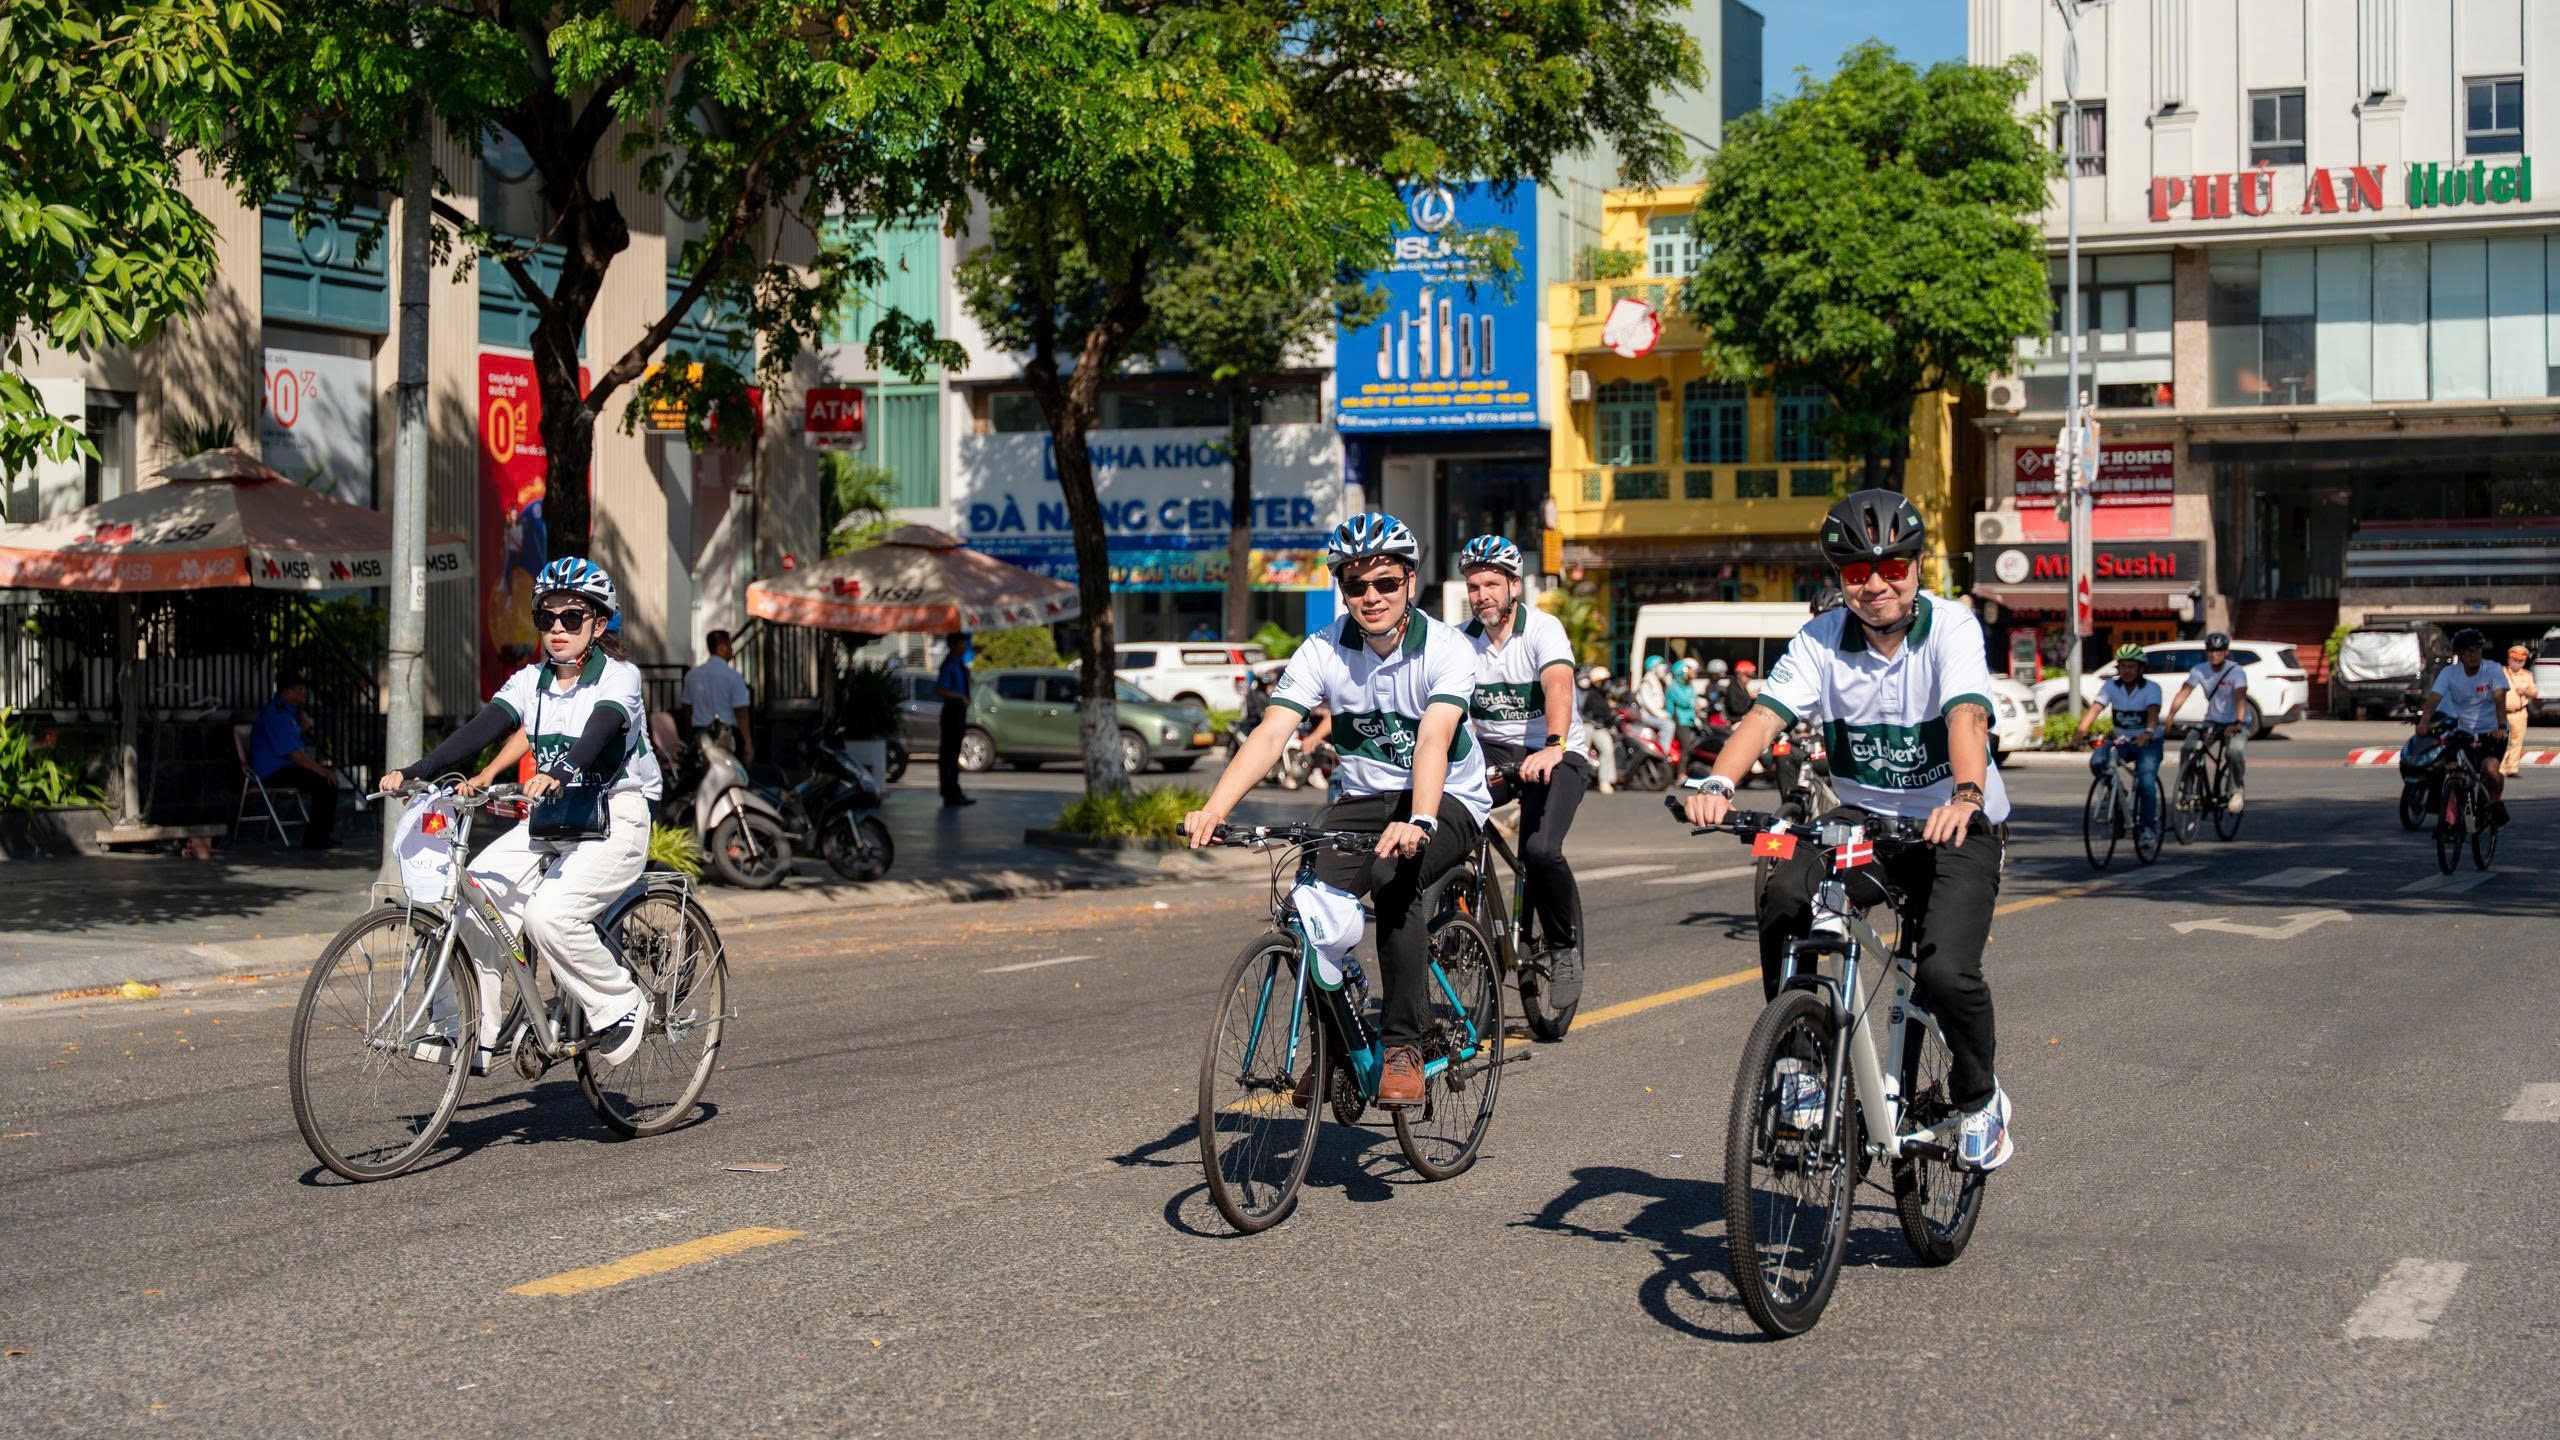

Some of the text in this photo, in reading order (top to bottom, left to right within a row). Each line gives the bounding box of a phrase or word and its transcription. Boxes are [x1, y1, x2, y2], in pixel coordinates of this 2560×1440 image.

[2150, 156, 2532, 222] PHÚ AN Hotel
[811, 401, 858, 421] ATM
[1091, 444, 1234, 469] NHA KHOA
[2111, 450, 2172, 466] HOMES
[970, 494, 1317, 532] ĐÀ NNG CENTER
[281, 561, 311, 580] MSB
[351, 560, 382, 578] MSB
[426, 553, 459, 573] MSB
[2096, 551, 2176, 578] Sushi
[1473, 688, 1526, 709] Carlsberg
[1500, 708, 1543, 721] Vietnam
[1352, 717, 1416, 748] Carlerg
[1847, 731, 1929, 765] Carlsberg
[1885, 761, 1953, 788] Vietnam
[494, 919, 520, 953] martin
